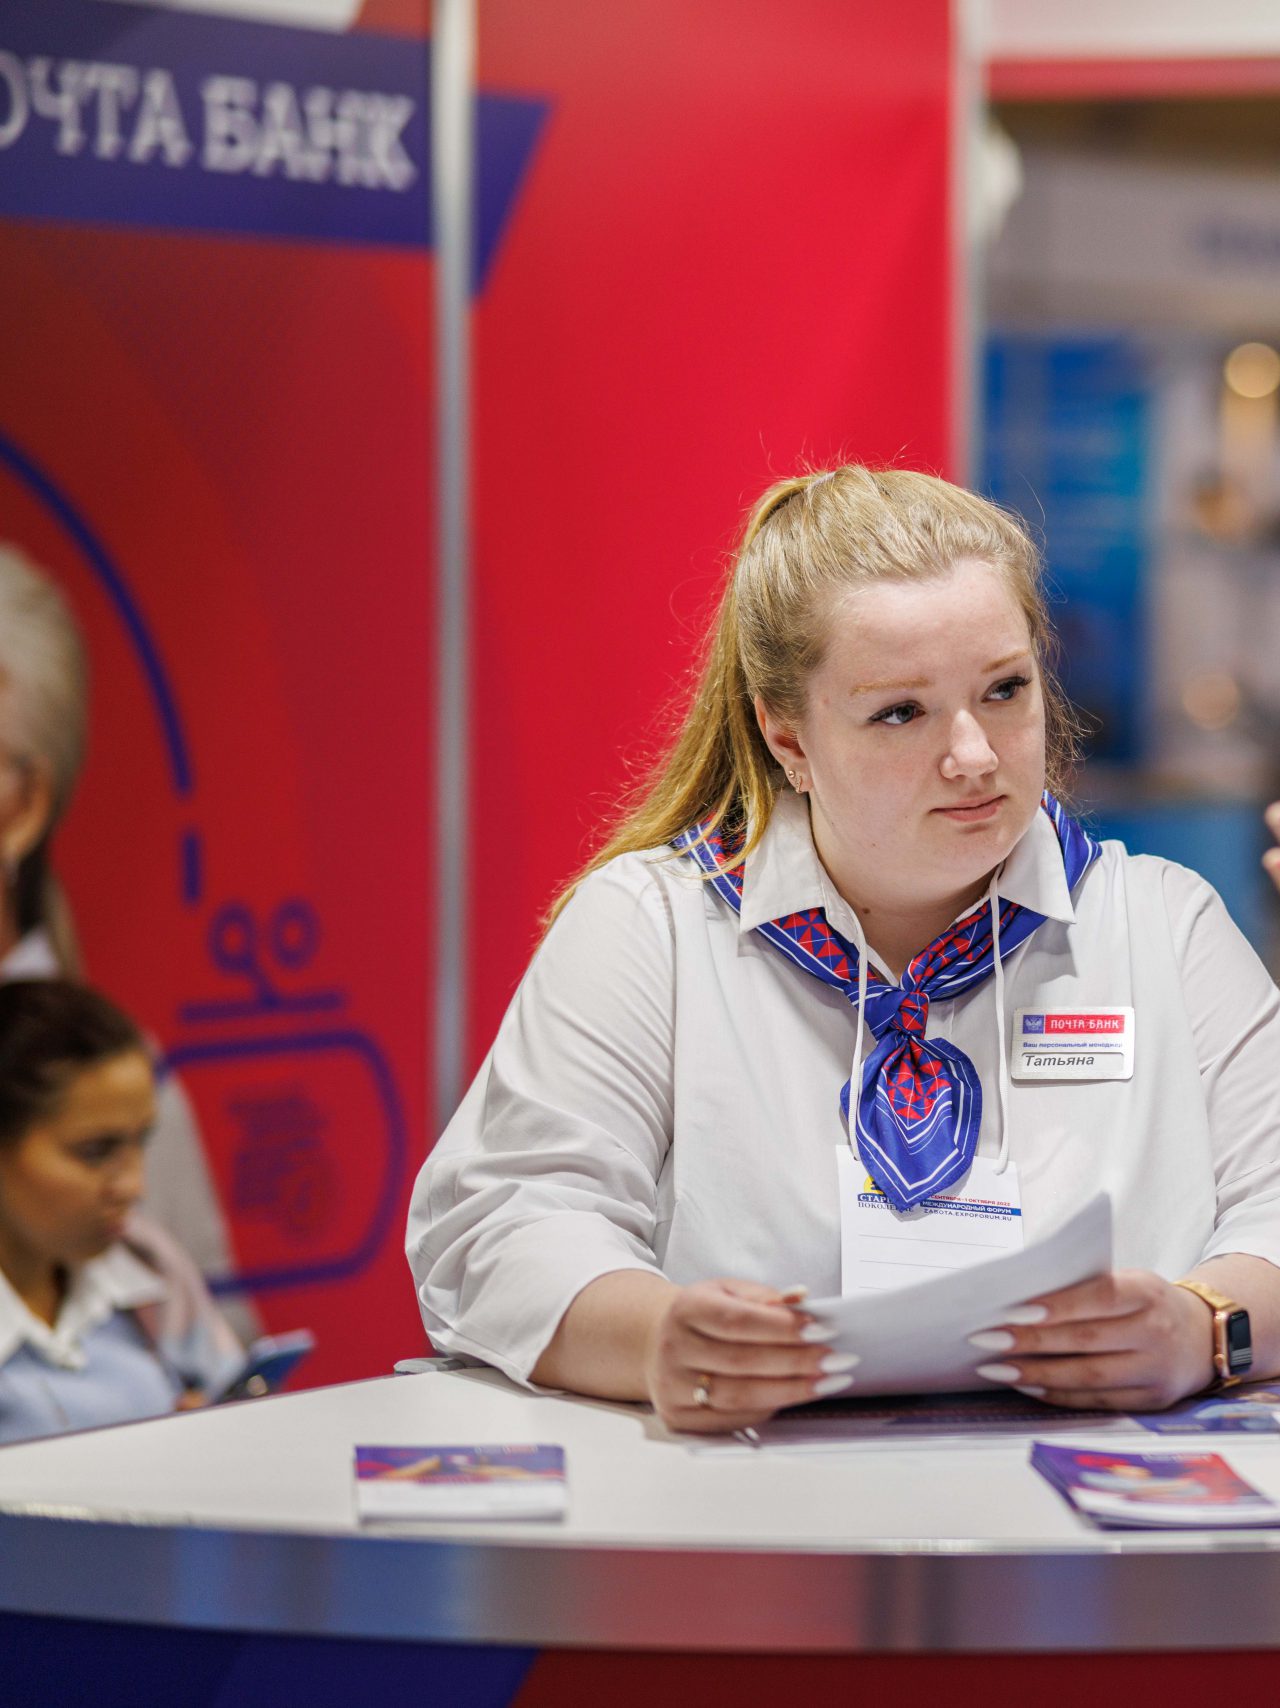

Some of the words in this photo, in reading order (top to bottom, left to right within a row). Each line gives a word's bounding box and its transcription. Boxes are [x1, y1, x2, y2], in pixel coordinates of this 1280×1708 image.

[201, 75, 417, 192] БАНК
[1050, 1019, 1085, 1029] ПОЧТА
[1089, 1019, 1120, 1029] БАНК
[1025, 1055, 1095, 1067] Татьяна
[859, 1194, 890, 1204] СТАР
[922, 1201, 986, 1212] МЕЖДУНАРОДНЫЙ
